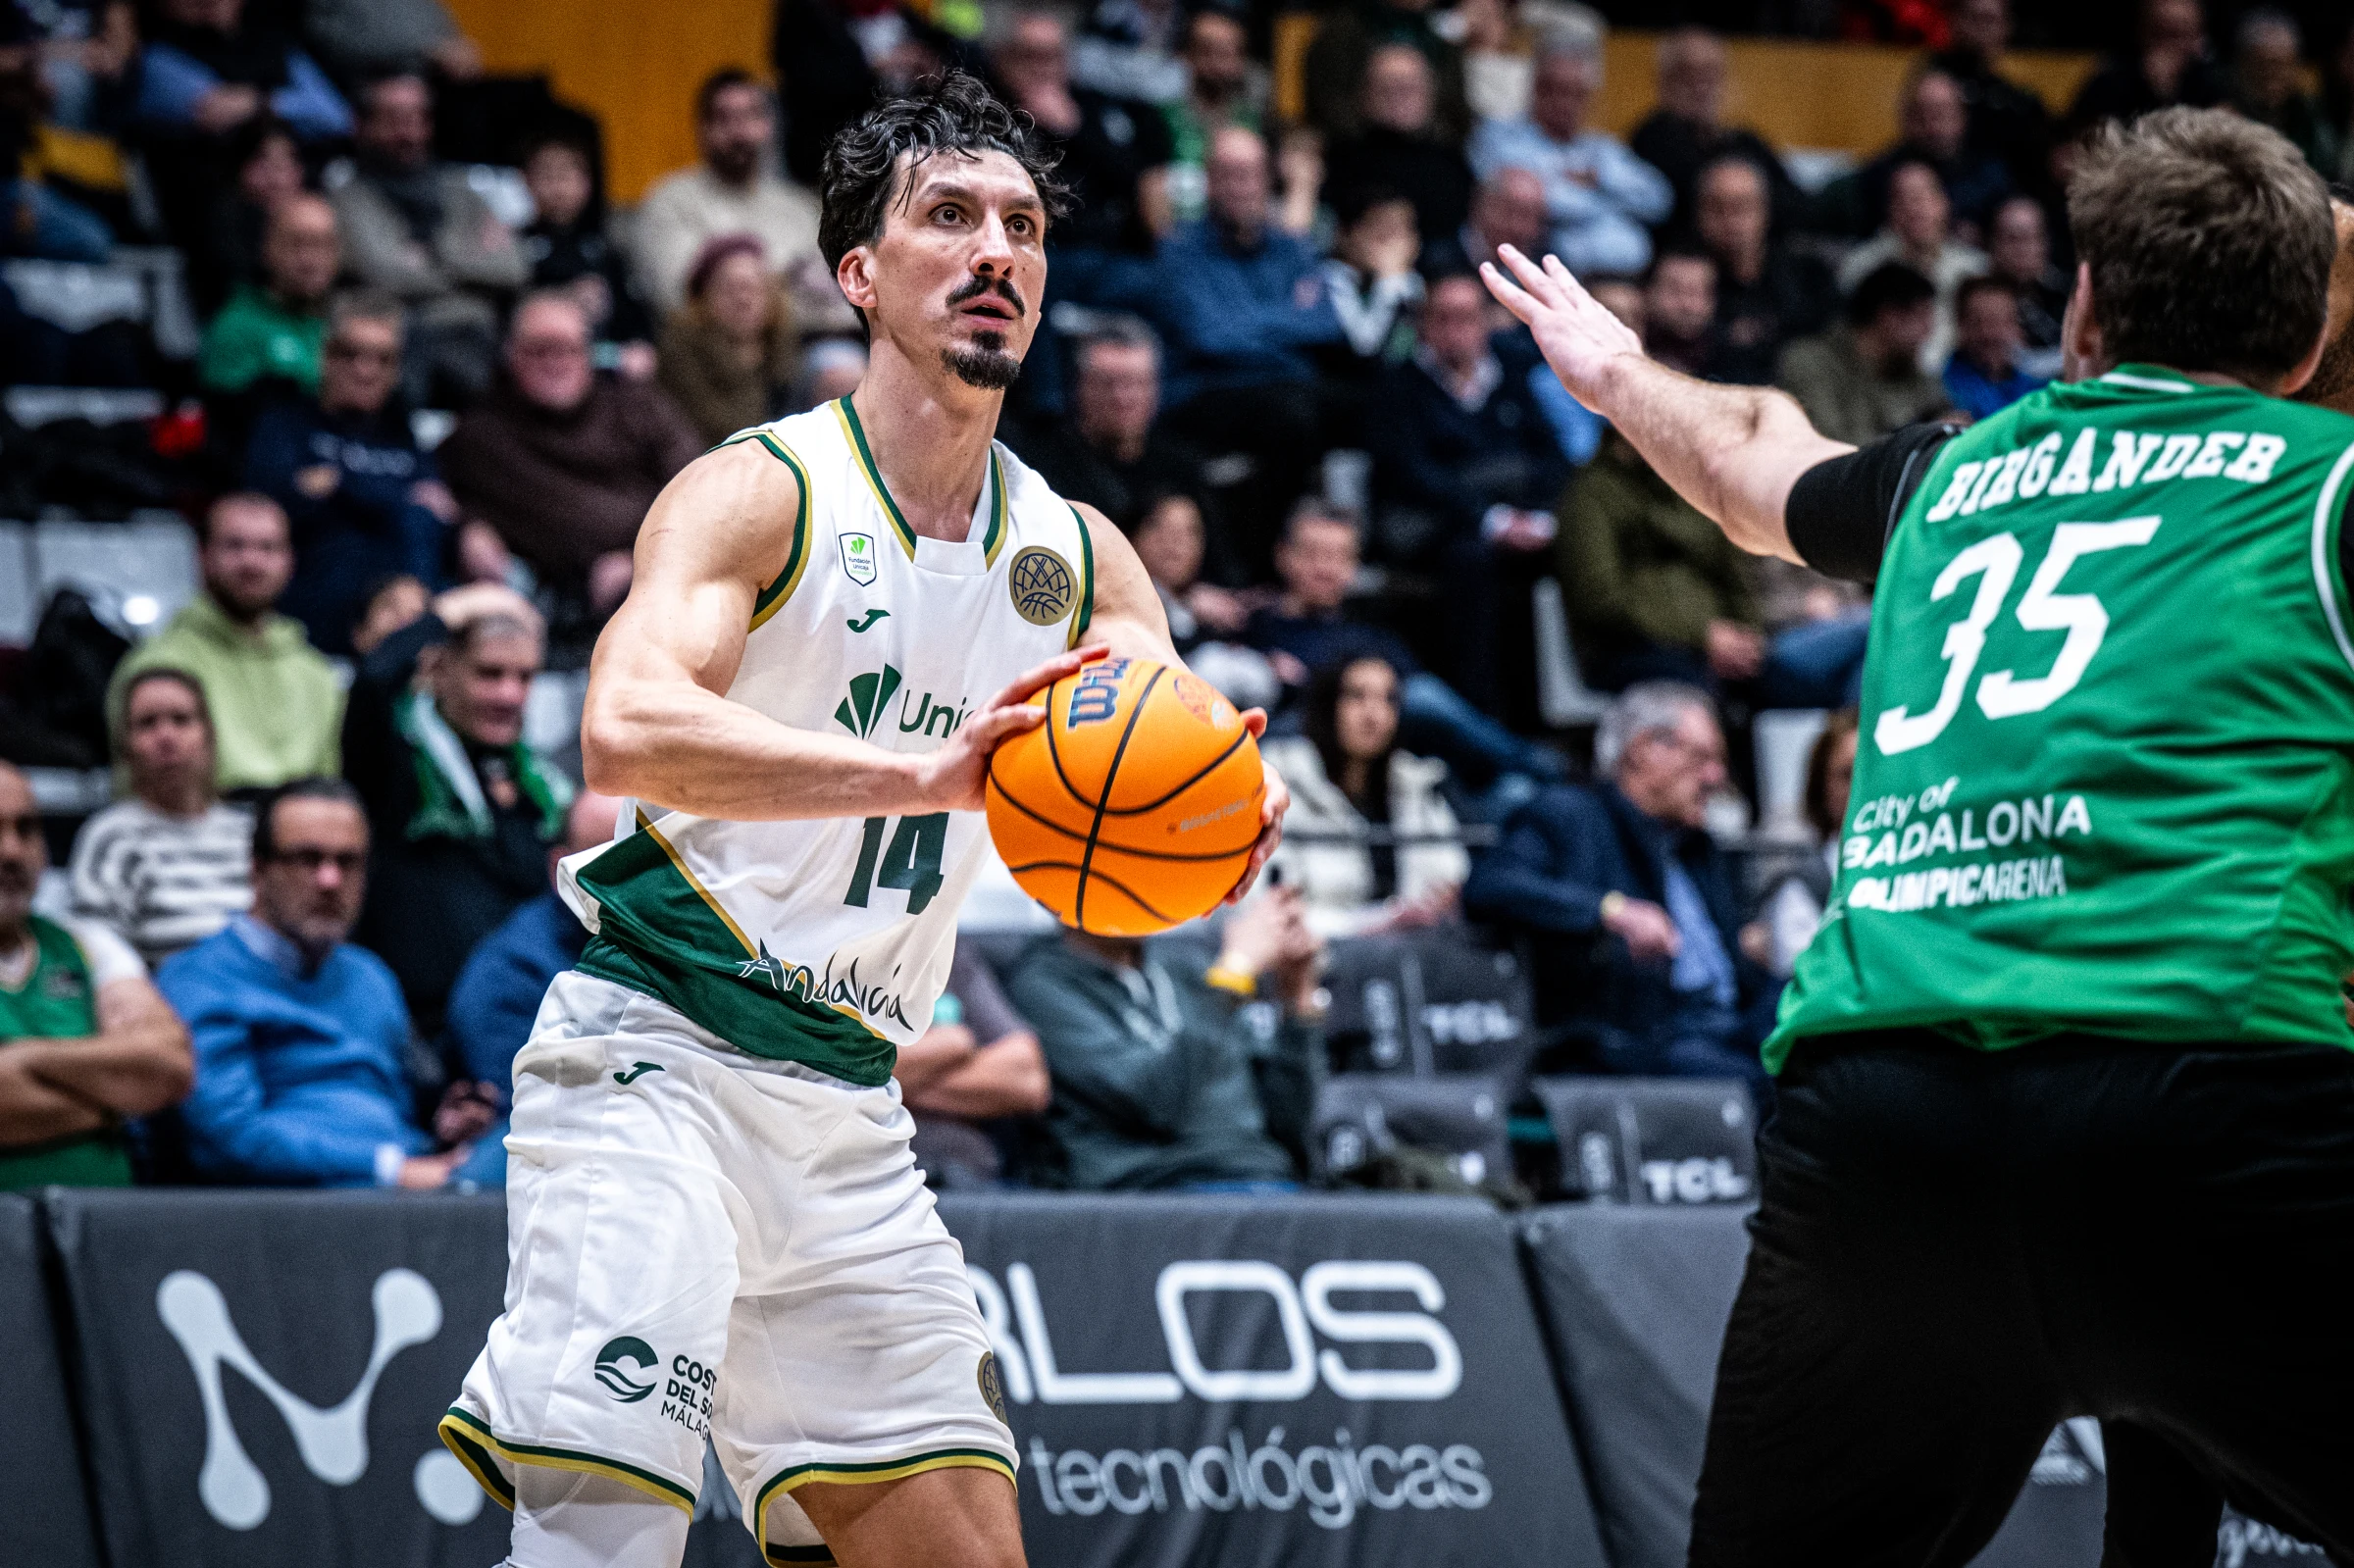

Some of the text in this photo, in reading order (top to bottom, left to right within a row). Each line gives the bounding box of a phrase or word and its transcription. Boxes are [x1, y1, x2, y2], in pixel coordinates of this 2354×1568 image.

[1926, 428, 2286, 522] BIRGANDER
[1873, 516, 2162, 755] 35
[899, 689, 975, 738] Uni
[1853, 775, 1960, 834] City of
[844, 812, 949, 915] 14
[1640, 1157, 1752, 1203] TCL
[666, 1378, 697, 1409] DEL
[1027, 1426, 1493, 1530] tecnológicas
